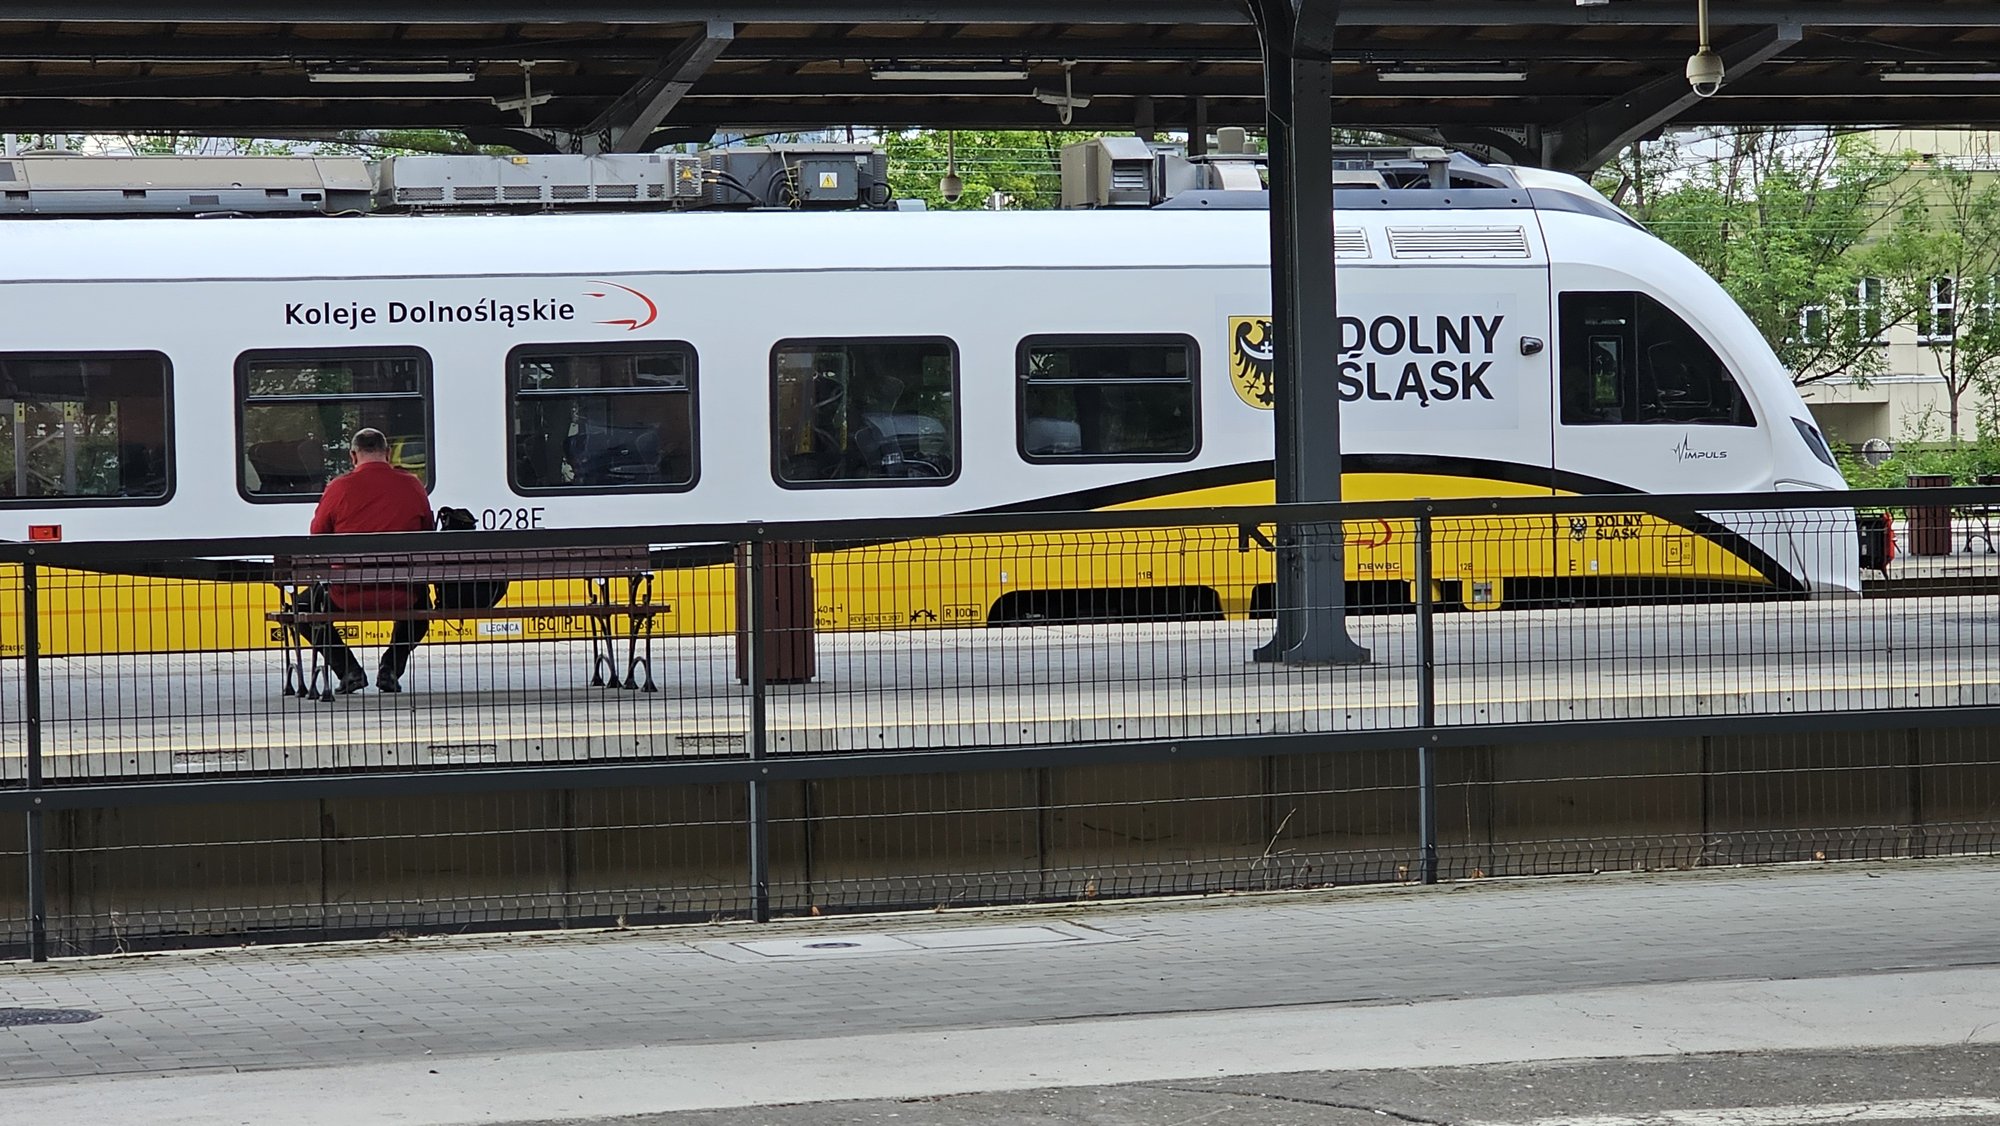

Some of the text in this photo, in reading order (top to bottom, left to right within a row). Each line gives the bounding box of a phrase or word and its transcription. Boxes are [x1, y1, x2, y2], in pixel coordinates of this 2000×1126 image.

[285, 298, 575, 330] Koleje Dolnośląskie
[1337, 315, 1505, 355] DOLNY
[1337, 353, 1495, 408] ŚLĄSK
[1684, 450, 1728, 459] IMPULS
[1238, 522, 1277, 552] K
[485, 623, 520, 632] LEGNCA
[945, 608, 952, 619] R
